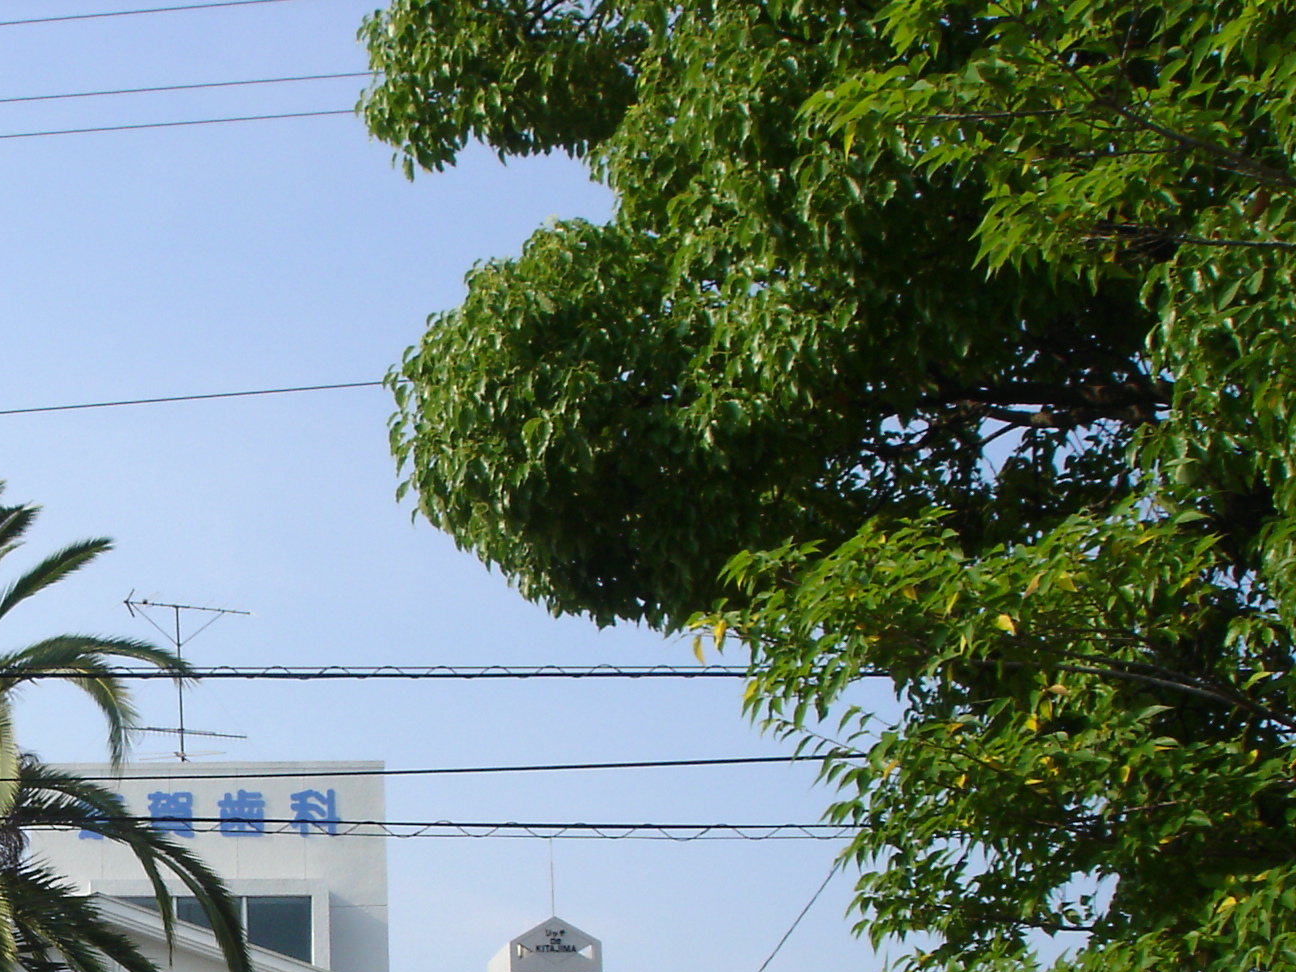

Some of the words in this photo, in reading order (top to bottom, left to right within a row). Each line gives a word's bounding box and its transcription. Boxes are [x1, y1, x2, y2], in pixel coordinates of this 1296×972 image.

[78, 788, 341, 840] 賀歯科
[535, 944, 577, 953] KITAJIMA
